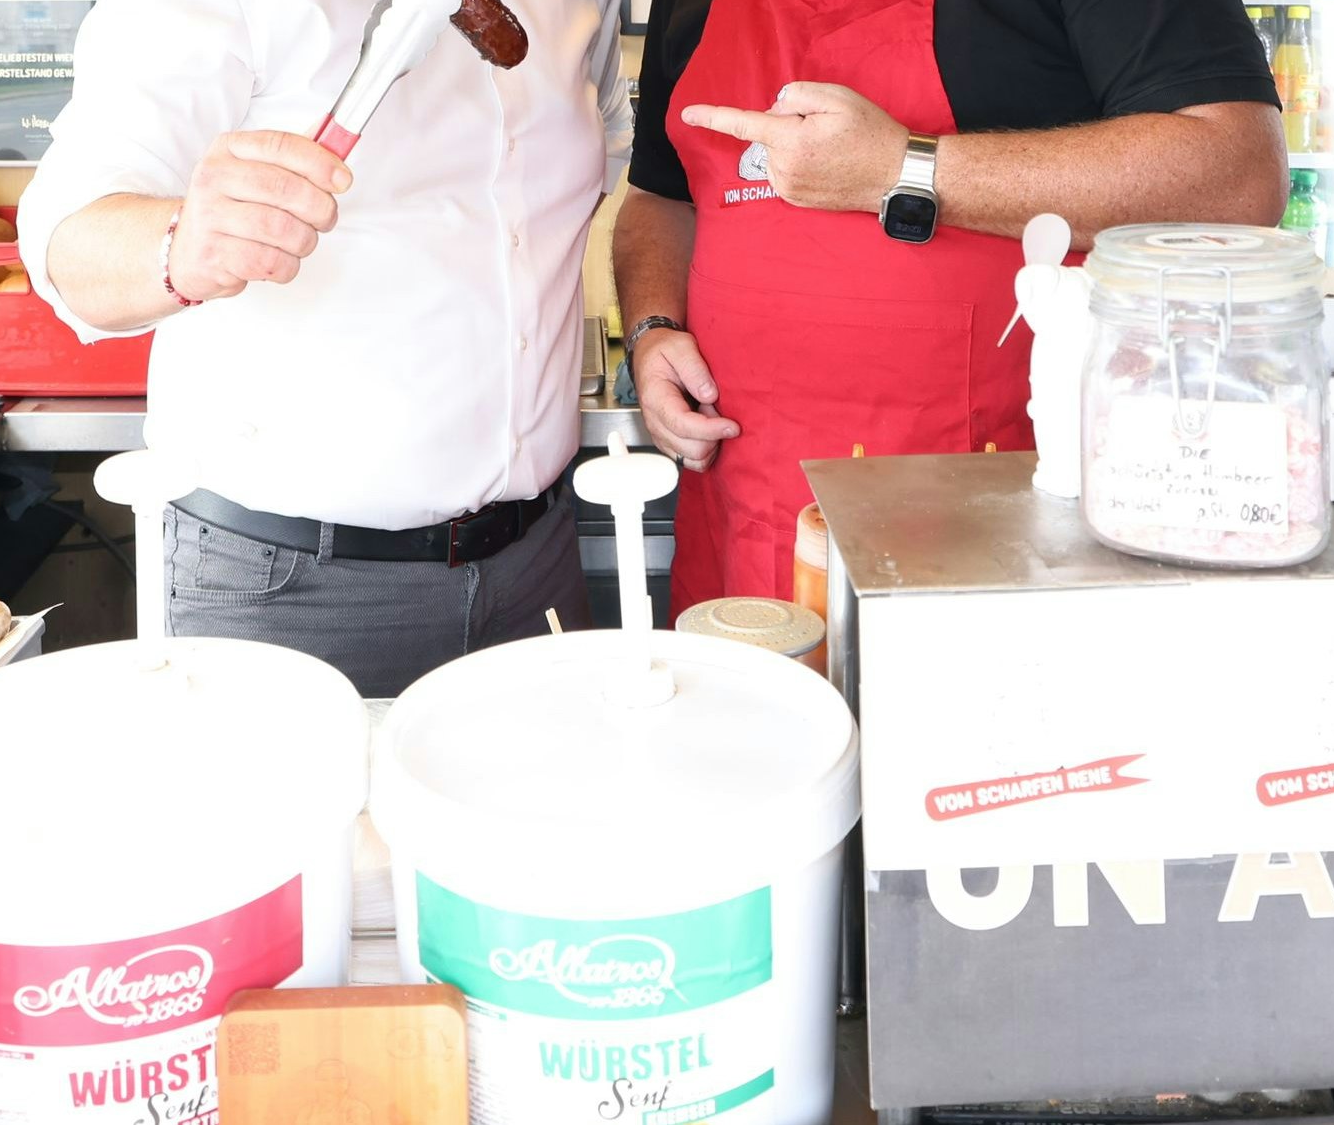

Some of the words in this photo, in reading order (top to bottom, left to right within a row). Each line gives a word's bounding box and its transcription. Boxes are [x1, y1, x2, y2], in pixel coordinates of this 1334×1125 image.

[724, 189, 741, 204] VOM
[935, 792, 973, 814] VOM
[976, 776, 1064, 807] SCHARFEN
[1068, 766, 1113, 790] RENE
[1265, 777, 1303, 800] VOM
[14, 945, 214, 1024] Albatros
[489, 934, 676, 1008] Albatros
[145, 989, 206, 1023] 1866
[612, 985, 666, 1007] 1866
[69, 1042, 217, 1107] WÜRST
[538, 1032, 713, 1082] WÜRSTEL
[598, 1077, 672, 1120] Senf
